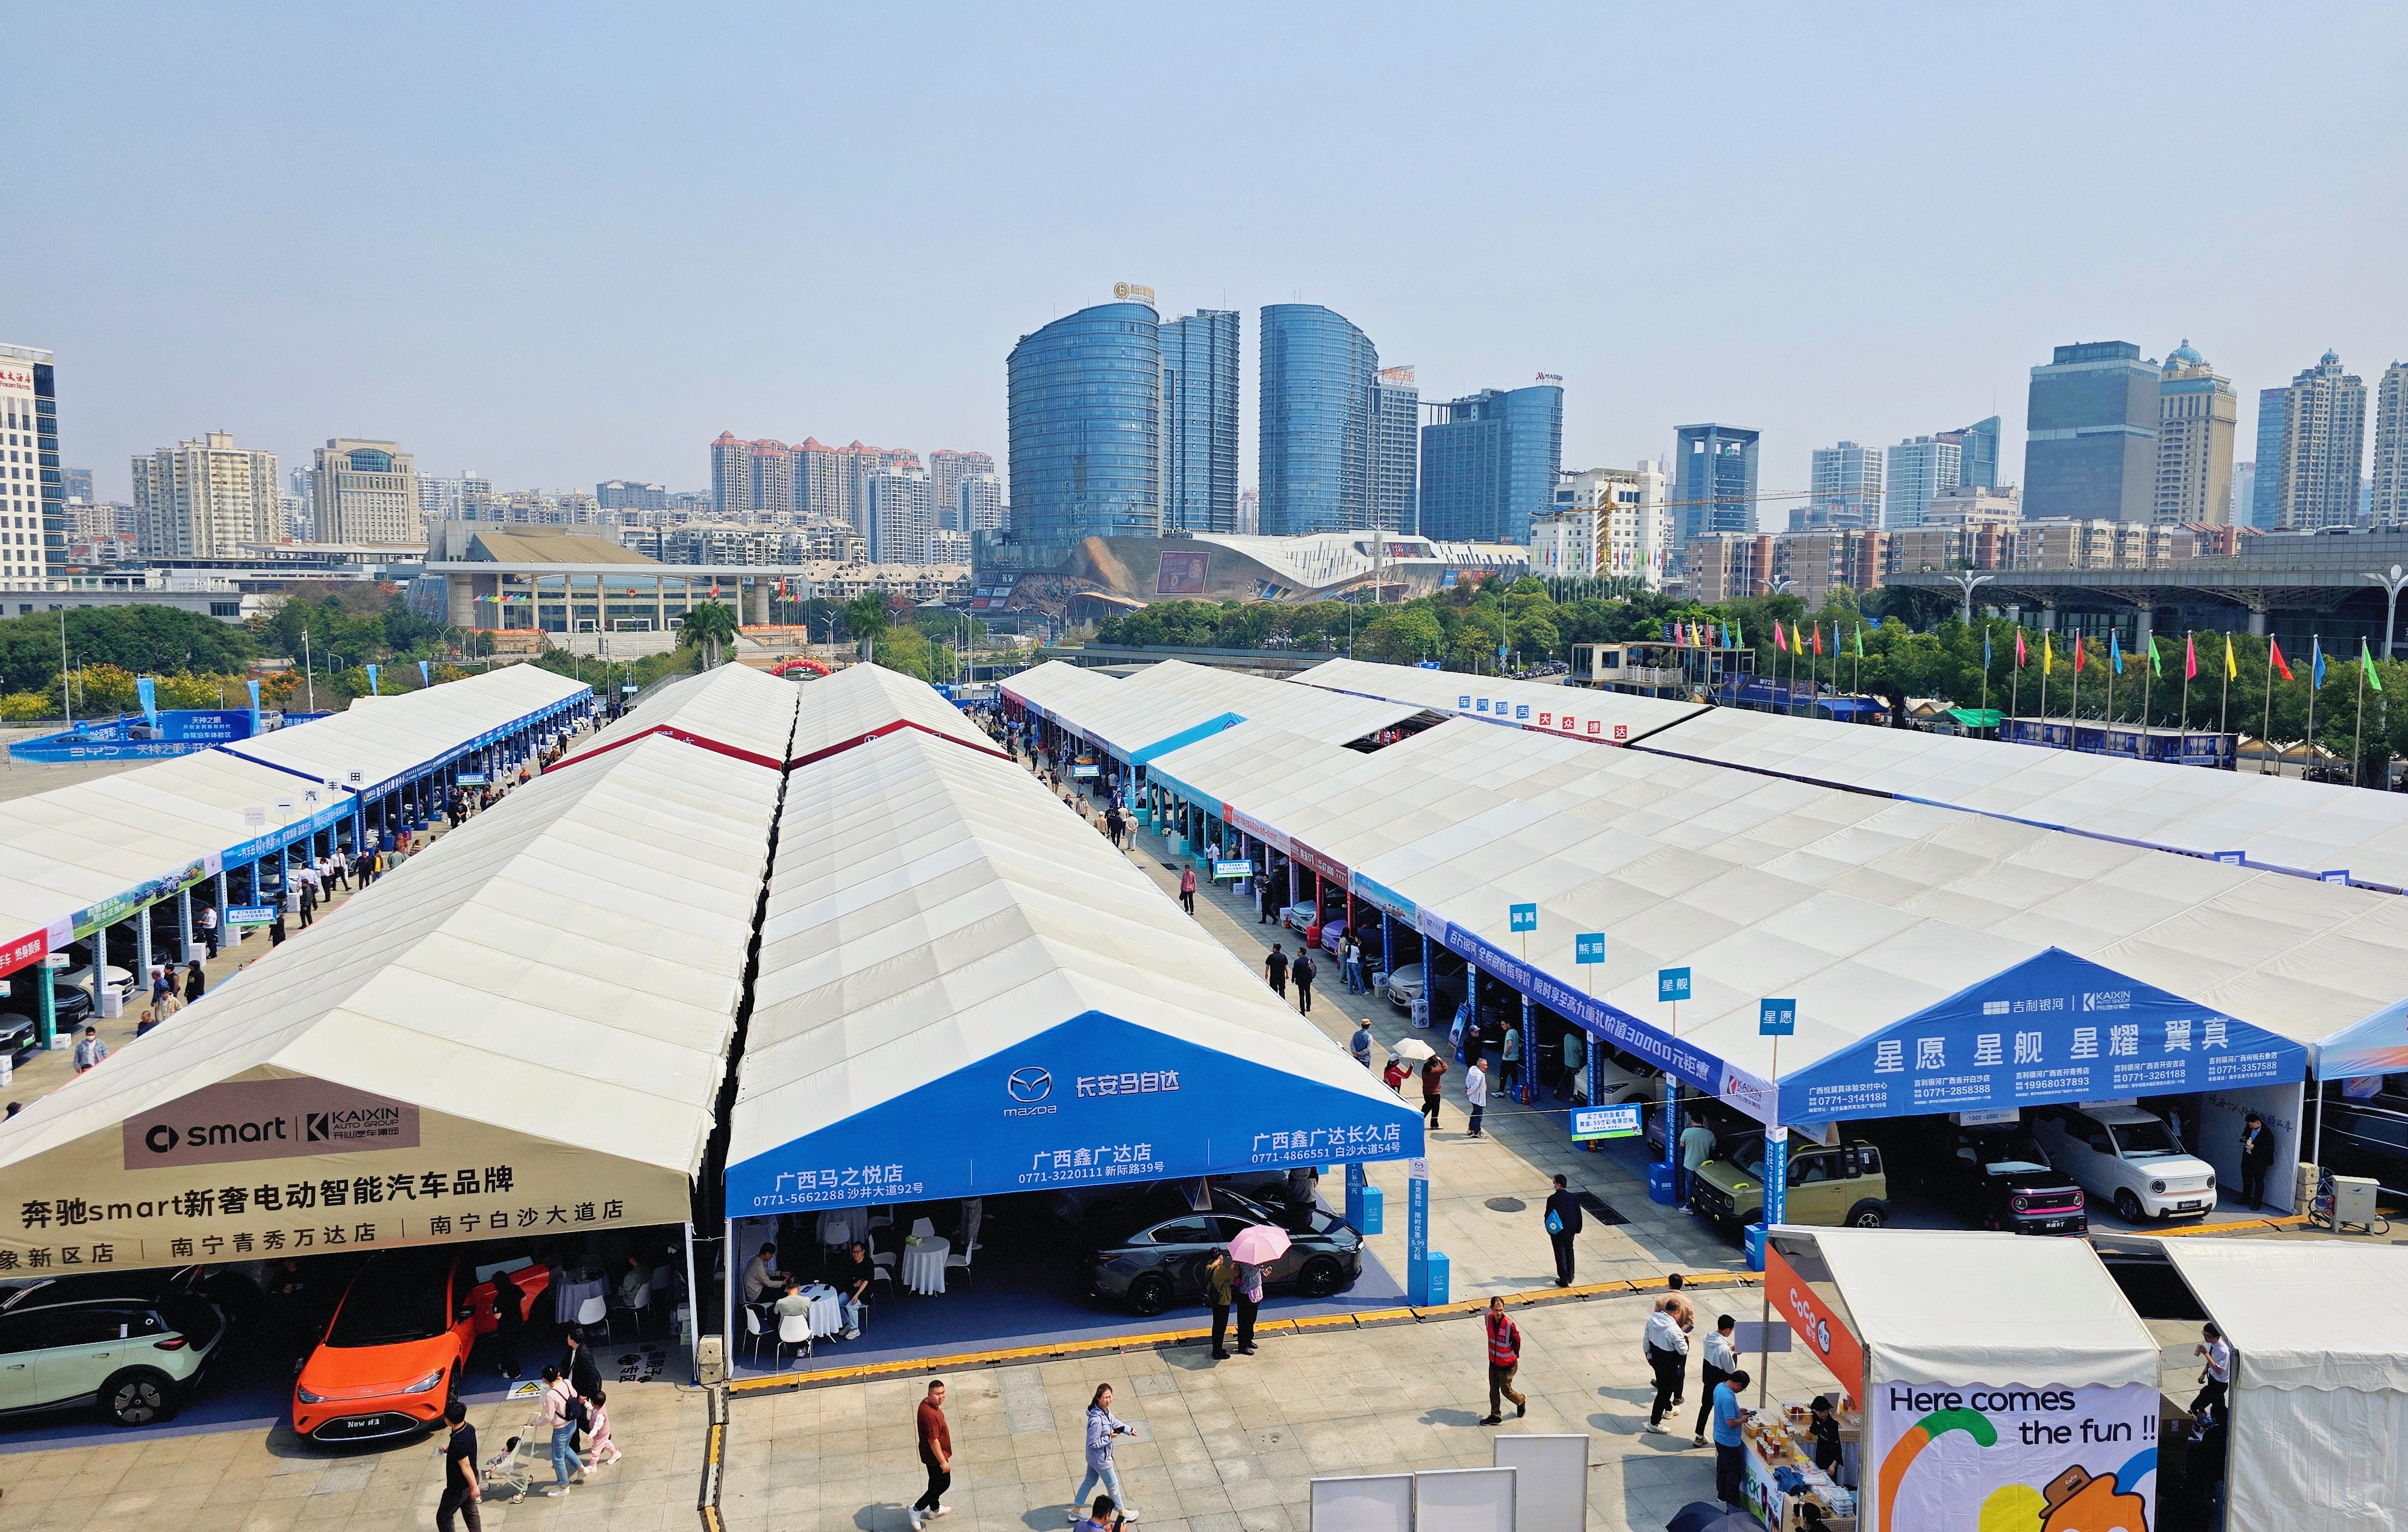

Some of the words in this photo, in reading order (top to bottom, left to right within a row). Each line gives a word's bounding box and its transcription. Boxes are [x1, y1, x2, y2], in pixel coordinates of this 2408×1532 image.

[1460, 698, 1469, 706] 车
[1478, 700, 1488, 709] 汽
[1496, 703, 1507, 713] 利
[1518, 707, 1527, 717] 吉
[1541, 714, 1550, 724] 大
[1564, 718, 1573, 728] 众
[1589, 722, 1600, 733] 捷
[1615, 727, 1626, 737] 达
[137, 742, 185, 755] 天神之眼
[305, 790, 317, 801] 汽
[328, 781, 338, 791] 丰
[351, 772, 360, 781] 田
[1512, 911, 1535, 924] 翼真
[15, 939, 42, 961] 终身质保
[1450, 929, 1477, 957] 百万银河
[1578, 942, 1603, 955] 熊猫
[1662, 977, 1688, 992] 星舰
[2012, 997, 2064, 1013] 吉利银河
[2096, 990, 2130, 1001] KAIXIN
[1763, 1009, 1793, 1024] 星愿
[1874, 1036, 1946, 1074] 星愿
[1973, 1030, 2044, 1067] 星舰
[2070, 1024, 2139, 1060] 星耀
[2164, 1017, 2229, 1053] 翼真
[2122, 1069, 2186, 1083] 0771-3261188
[2216, 1061, 2277, 1075] 0771-3357588
[1076, 1069, 1181, 1099] 长安马自达
[1923, 1084, 1991, 1098] 0771-2858388
[2024, 1077, 2089, 1090] 19968037893
[1818, 1092, 1887, 1106] 0771-3141188
[332, 1107, 399, 1123] KAIXIN
[364, 1119, 399, 1127] GROUP
[1587, 1111, 1626, 1120] 买了车别急着走
[187, 1116, 287, 1146] smart
[1252, 1122, 1401, 1152] 广西鑫广达长久店
[1032, 1142, 1152, 1171] 广西鑫广达店
[1252, 1148, 1329, 1163] 0771-4866551
[1335, 1142, 1401, 1158] 白沙大道54号
[775, 1163, 903, 1192] 广西马之悦店
[1018, 1167, 1102, 1184] 0771-3220111
[1105, 1161, 1164, 1177] 新际路39号
[20, 1165, 514, 1230] 奔驰smart新奢电动智能汽车品牌
[753, 1189, 844, 1207] 0771-5662288
[847, 1182, 924, 1199] 沙井大道92号
[170, 1222, 376, 1258] 南宁青秀万达店
[430, 1198, 624, 1236] 南宁白沙大道店
[1414, 1246, 1421, 1260] 万起
[1790, 1287, 1816, 1329] CoCo
[1890, 1387, 1963, 1412] Here
[1971, 1390, 2076, 1412] comes
[348, 1419, 365, 1428] New
[2018, 1419, 2072, 1445] the
[2080, 1418, 2132, 1443] fun
[2142, 1415, 2156, 1440] !!
[2064, 1474, 2078, 1486] CoCo
